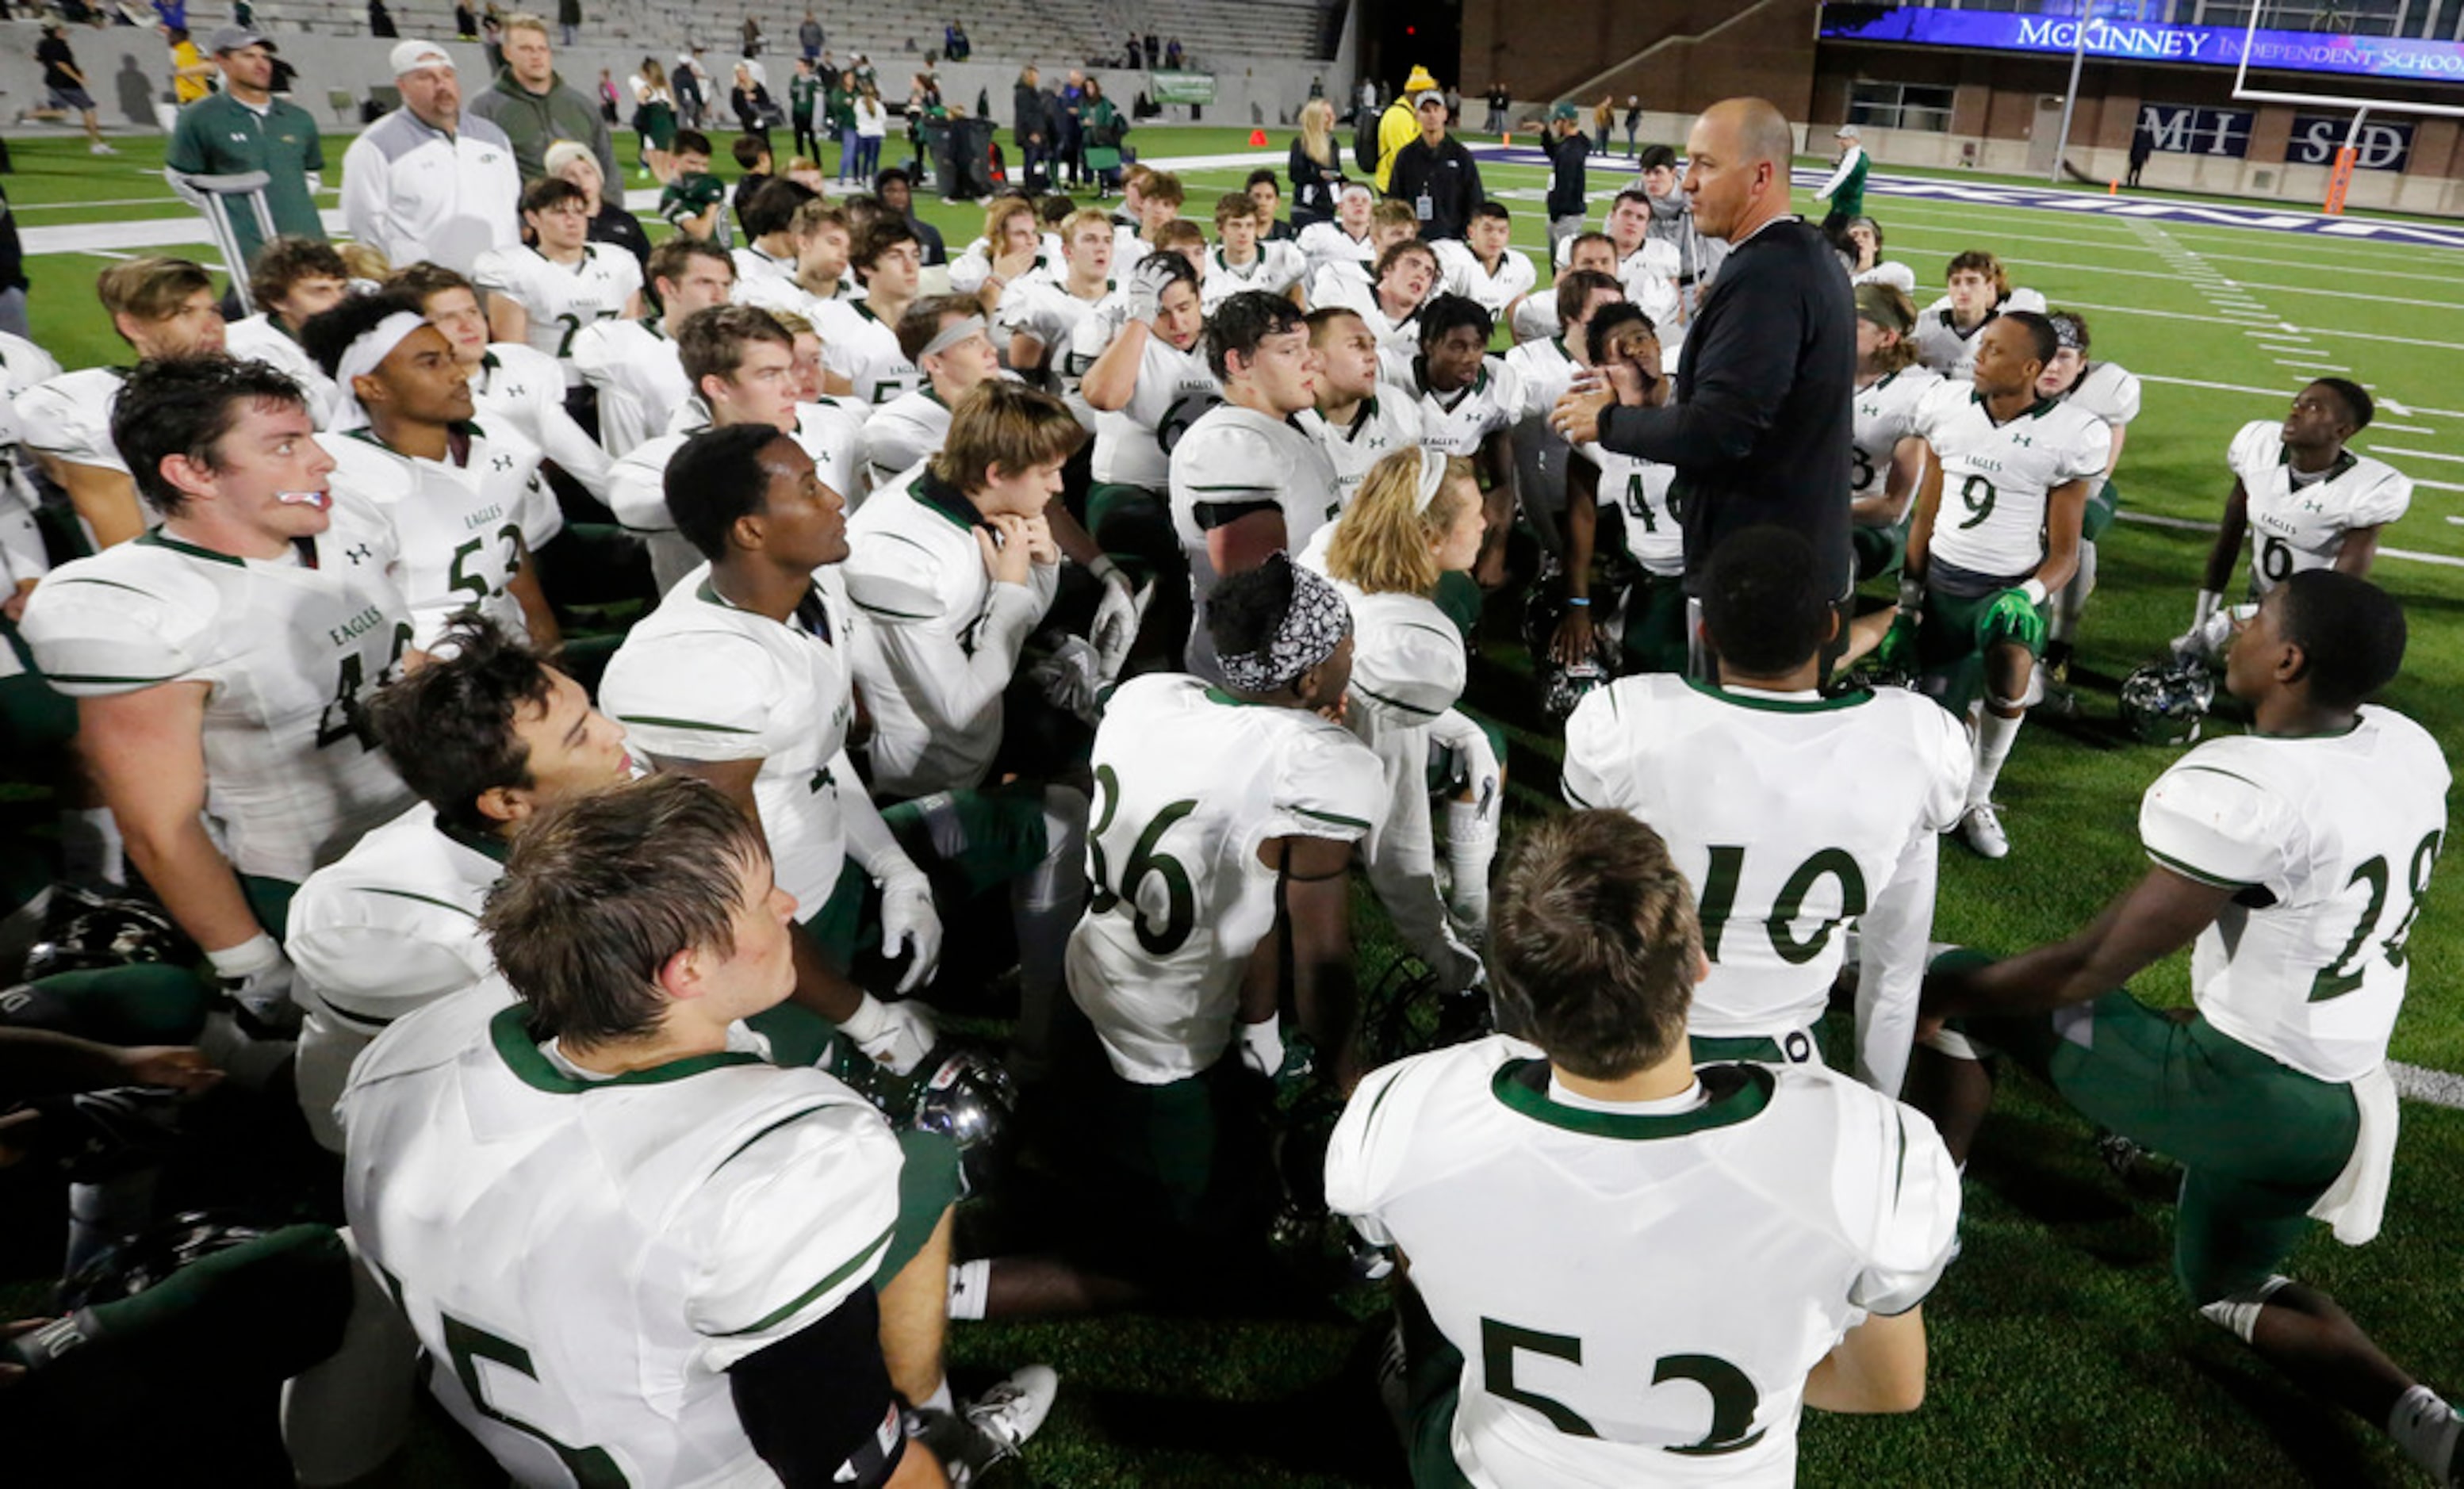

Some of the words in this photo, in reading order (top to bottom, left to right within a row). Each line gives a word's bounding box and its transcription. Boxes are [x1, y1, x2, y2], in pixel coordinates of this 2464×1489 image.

[1964, 454, 2003, 473] EAGLES
[465, 502, 504, 530] EAGLES
[1959, 474, 1995, 529] 9
[2261, 512, 2297, 535] EAGLES
[2262, 536, 2293, 583] 6
[328, 604, 384, 648] EAGLES
[1699, 844, 1868, 965] 10
